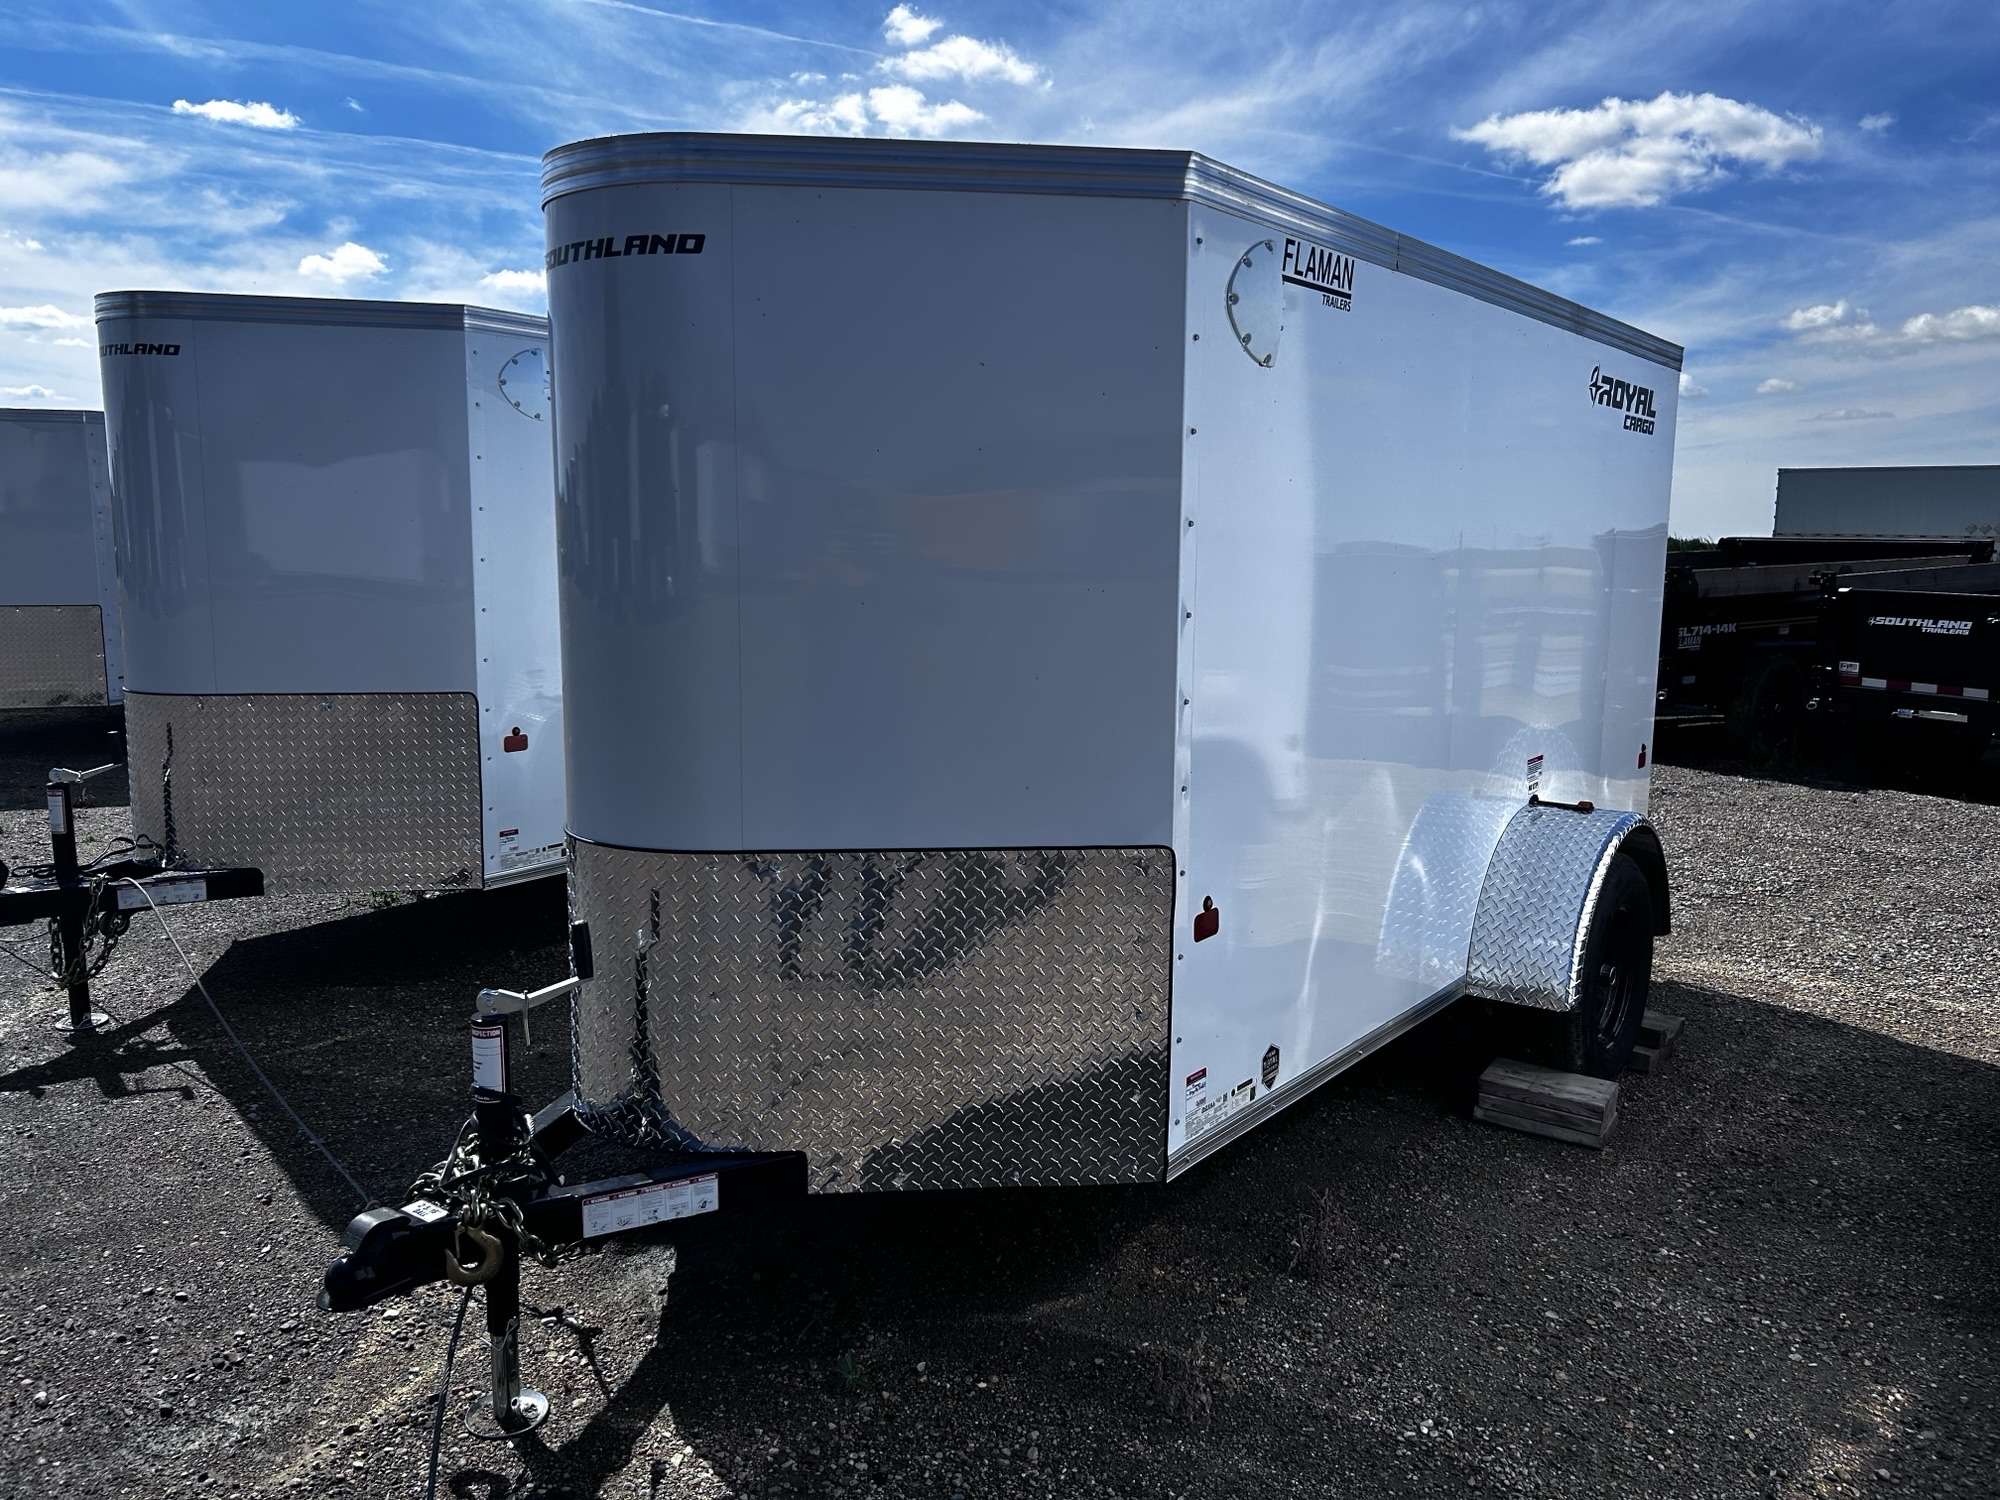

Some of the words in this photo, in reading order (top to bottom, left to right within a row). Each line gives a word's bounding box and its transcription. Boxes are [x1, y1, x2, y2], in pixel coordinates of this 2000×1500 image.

[545, 233, 706, 271] OUTHLAND
[1282, 237, 1355, 291] FLAMAN
[1321, 293, 1352, 312] TRAILERS
[1597, 374, 1657, 418] ROYAL
[1623, 414, 1656, 435] CARGO
[1874, 616, 1973, 630] SOUTHLAND
[1921, 627, 1970, 636] TRAILERS
